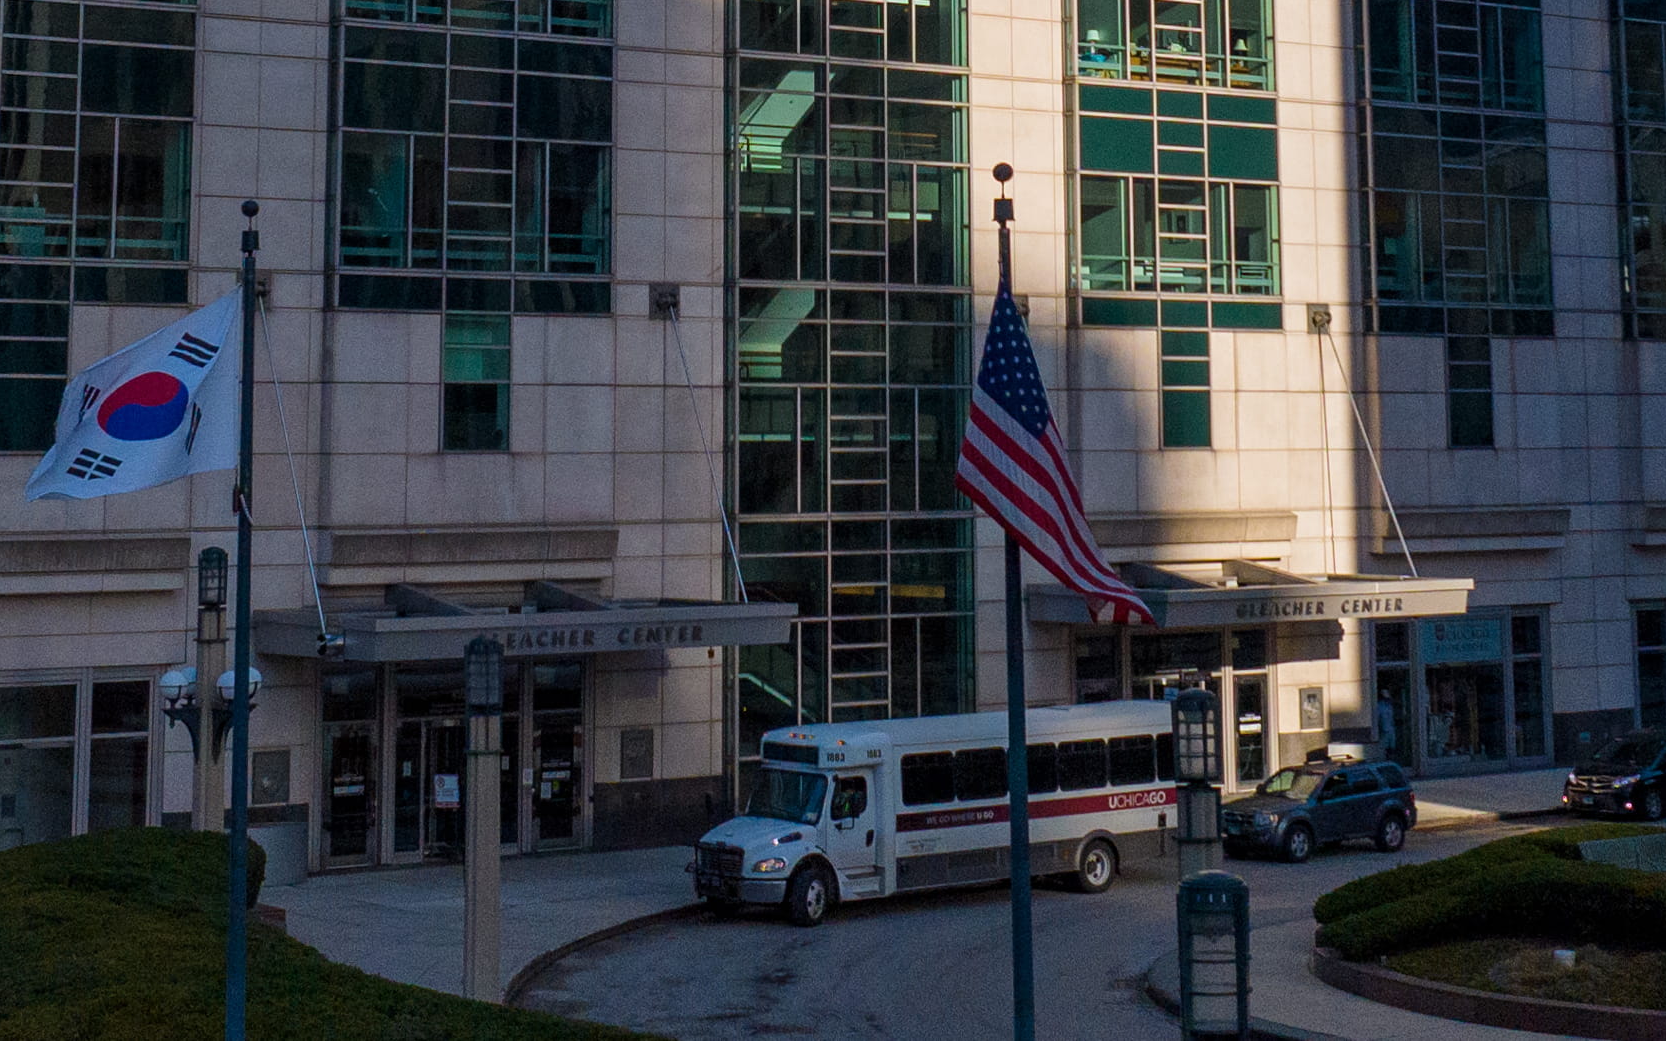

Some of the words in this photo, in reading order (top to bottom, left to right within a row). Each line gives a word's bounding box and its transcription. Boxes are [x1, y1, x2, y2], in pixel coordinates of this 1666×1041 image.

[1236, 600, 1324, 619] GLEACHER
[1340, 598, 1403, 615] CENTER
[493, 629, 595, 650] EACHER
[617, 625, 703, 645] CENTER
[1108, 790, 1166, 809] UCHICAGO
[938, 814, 950, 823] GO
